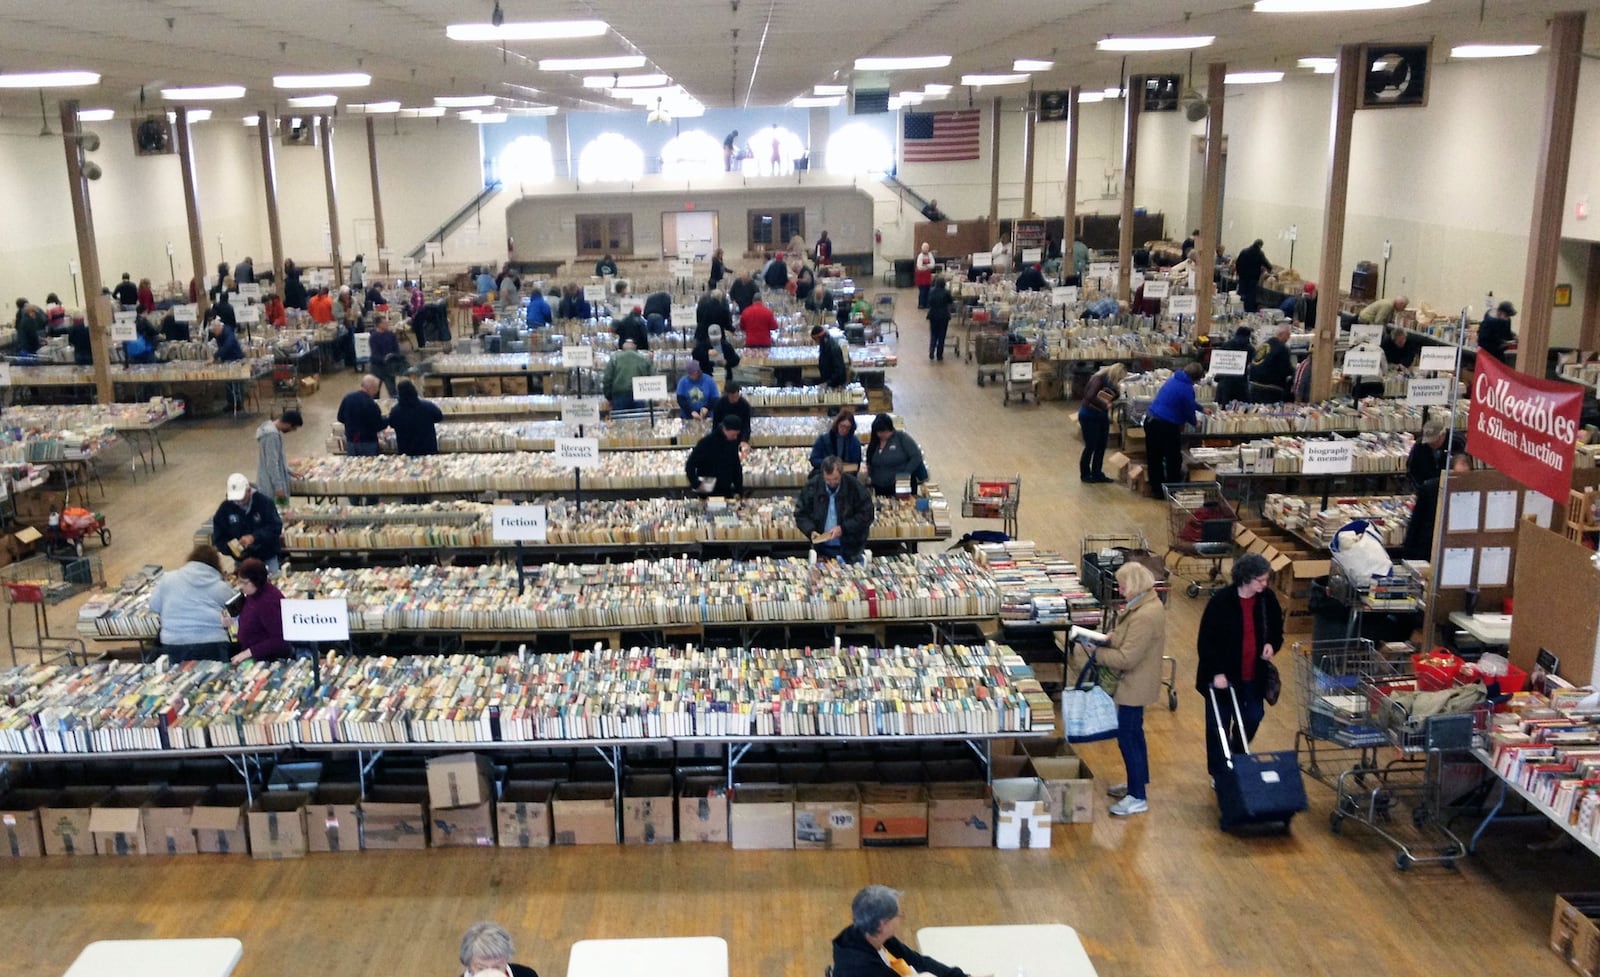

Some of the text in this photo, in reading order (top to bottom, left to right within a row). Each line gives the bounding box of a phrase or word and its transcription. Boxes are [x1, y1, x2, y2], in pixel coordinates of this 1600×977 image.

[1475, 372, 1575, 445] Collectibles
[1477, 412, 1563, 471] & Silent Auction
[561, 443, 591, 452] literary
[1308, 446, 1349, 455] biography
[561, 450, 592, 458] classics
[501, 516, 538, 526] fiction
[292, 613, 337, 624] fiction
